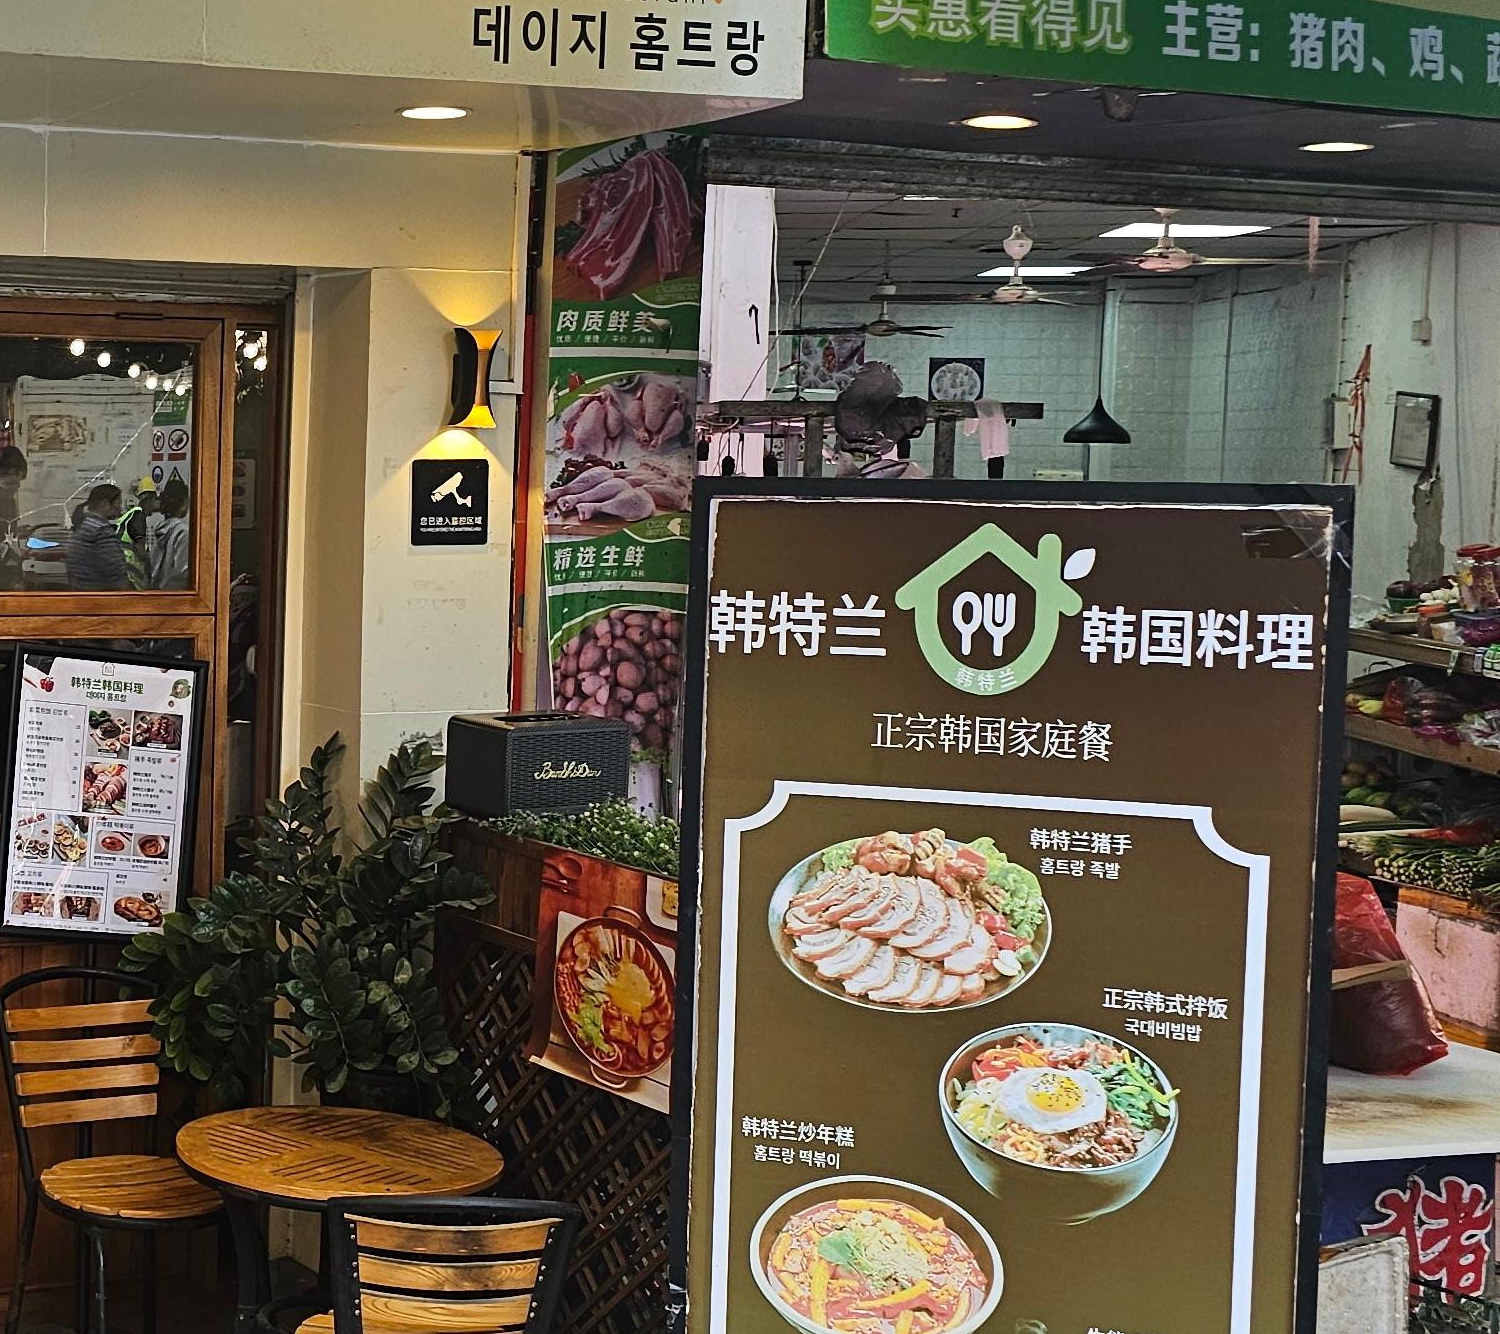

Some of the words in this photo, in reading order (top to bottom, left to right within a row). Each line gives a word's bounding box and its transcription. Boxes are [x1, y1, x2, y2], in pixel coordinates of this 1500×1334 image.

[472, 5, 607, 70] 데이지
[630, 12, 765, 77] 홈트랑
[556, 310, 656, 332] 肉质鲜美
[553, 545, 645, 570] 精选生鲜
[709, 590, 887, 657] 韩特兰
[1081, 606, 1315, 670] 韩国料理
[71, 677, 144, 694] 韩特兰韩国料理
[955, 667, 1018, 692] 韩特兰
[870, 712, 1113, 762] 正宗韩国家庭餐
[1029, 828, 1132, 856] 韩特兰猪手
[1040, 857, 1086, 878] 홈트랑
[1090, 859, 1121, 879] 족발
[1102, 987, 1228, 1021] 正宗韩式拌饭
[1124, 1019, 1203, 1042] 국대비빔밥
[741, 1116, 854, 1148] 韩特兰炒年糕
[753, 1145, 795, 1165] 홈트랑
[799, 1148, 840, 1169] 떡볶이
